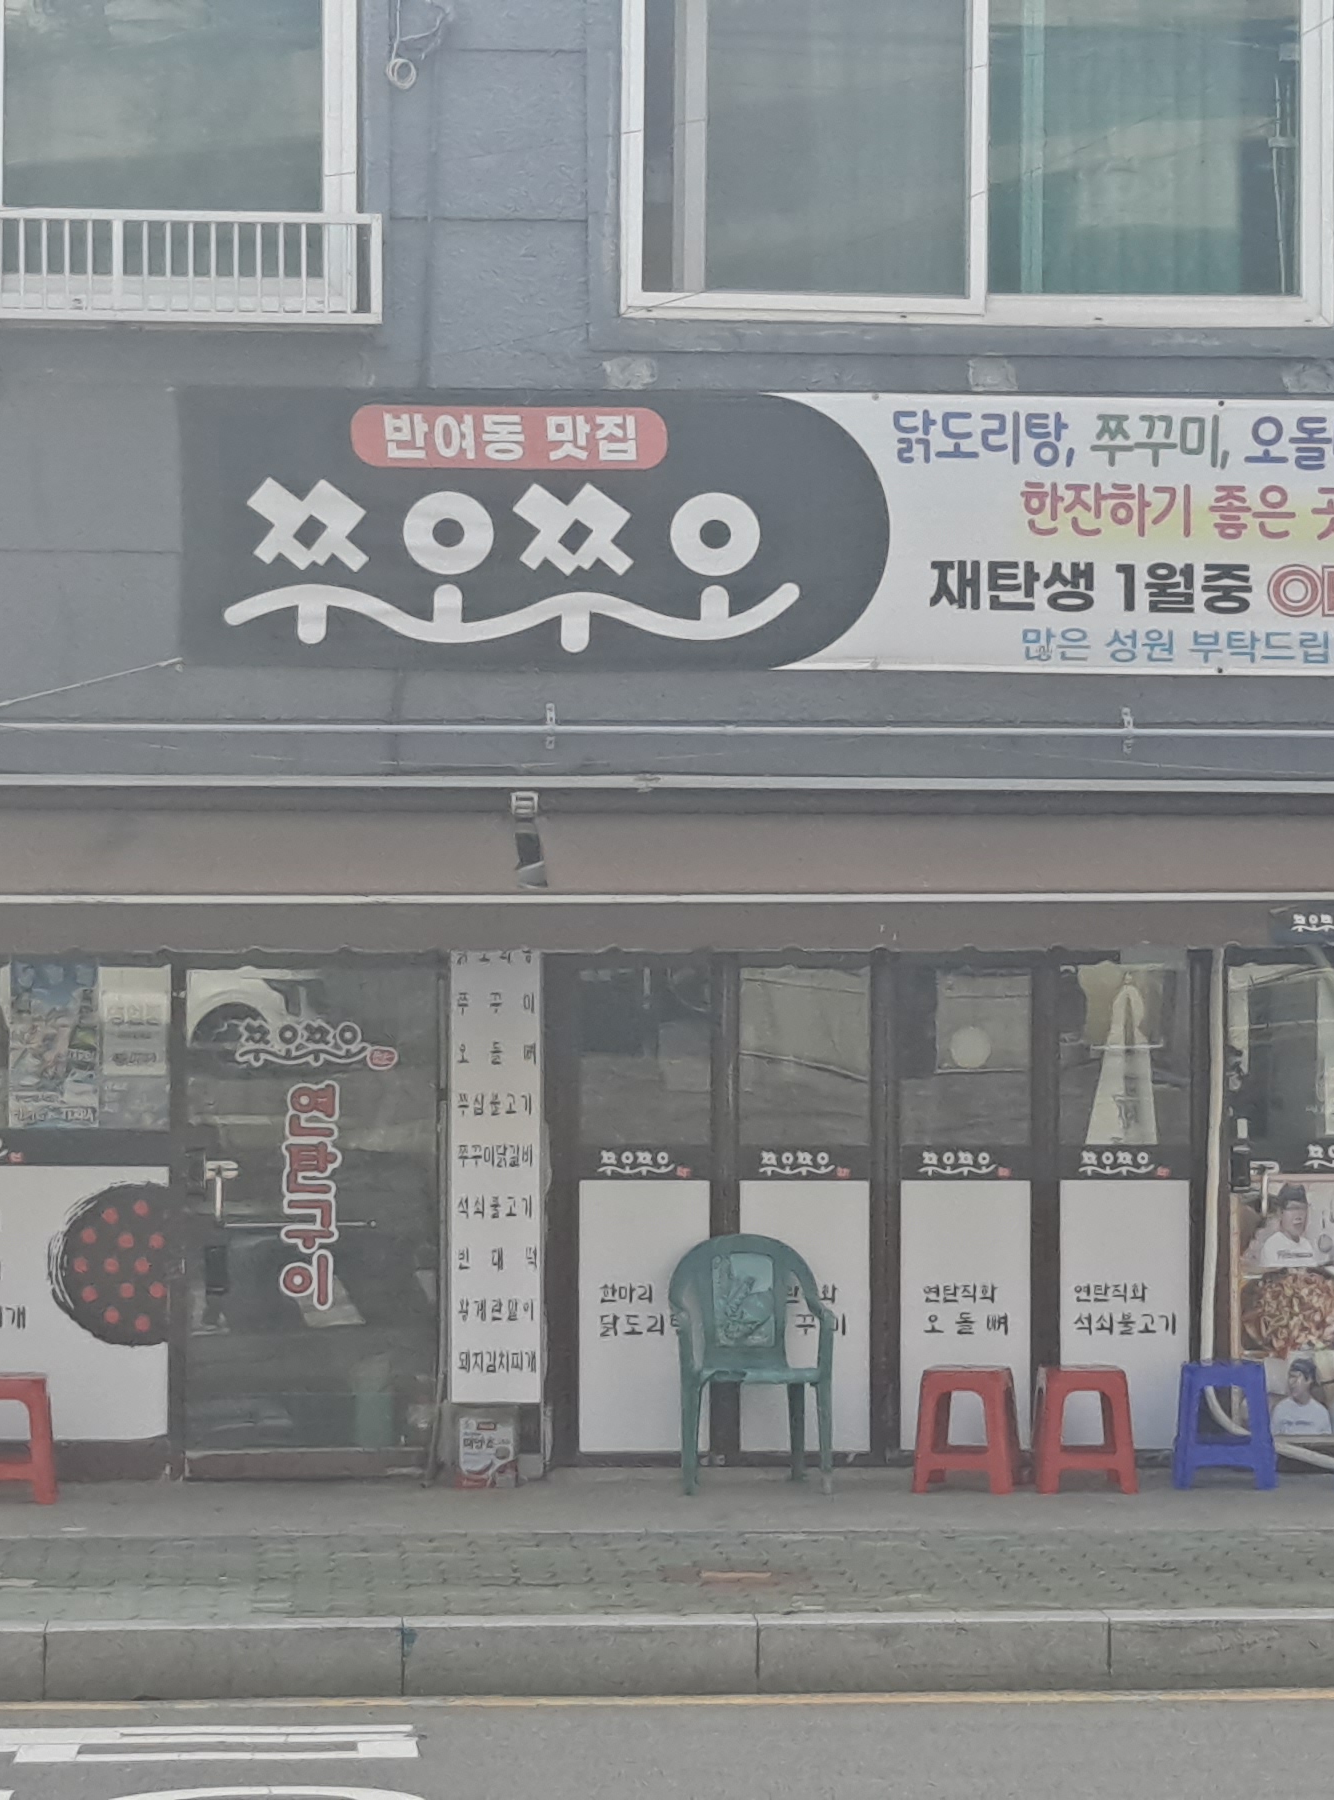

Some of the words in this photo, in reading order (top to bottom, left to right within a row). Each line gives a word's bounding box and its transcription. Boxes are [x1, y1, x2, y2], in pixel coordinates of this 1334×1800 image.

[383, 411, 525, 461] 반여동
[546, 412, 638, 463] 맛집
[893, 409, 1075, 467] 닭도리탕,
[1090, 413, 1229, 470] 쭈꾸미,
[1020, 481, 1191, 538] 한잔하기
[1208, 484, 1296, 539] 좋은
[929, 559, 1095, 613] 재탄생
[1115, 561, 1253, 615] 1월중
[1022, 627, 1091, 662] 많은
[1104, 628, 1173, 663] 성원
[457, 991, 535, 1016] 쭈꾸미
[457, 1092, 533, 1116] 쭈삼불고기
[457, 1143, 534, 1168] 쭈꾸미닭갈비
[280, 1080, 342, 1310] 연탄구이
[457, 1195, 533, 1219] 석쇠불고기
[457, 1247, 538, 1272] 빈대떡
[600, 1283, 653, 1304] 한마리
[923, 1283, 998, 1304] 연탄직화
[1073, 1282, 1148, 1304] 연탄직화
[457, 1298, 534, 1322] 왕계란말이
[599, 1314, 680, 1338] 닭도리
[923, 1312, 1009, 1336] 오돌뼈
[1073, 1312, 1177, 1336] 석쇠불고기
[457, 1350, 537, 1374] 돼지김치찌개
